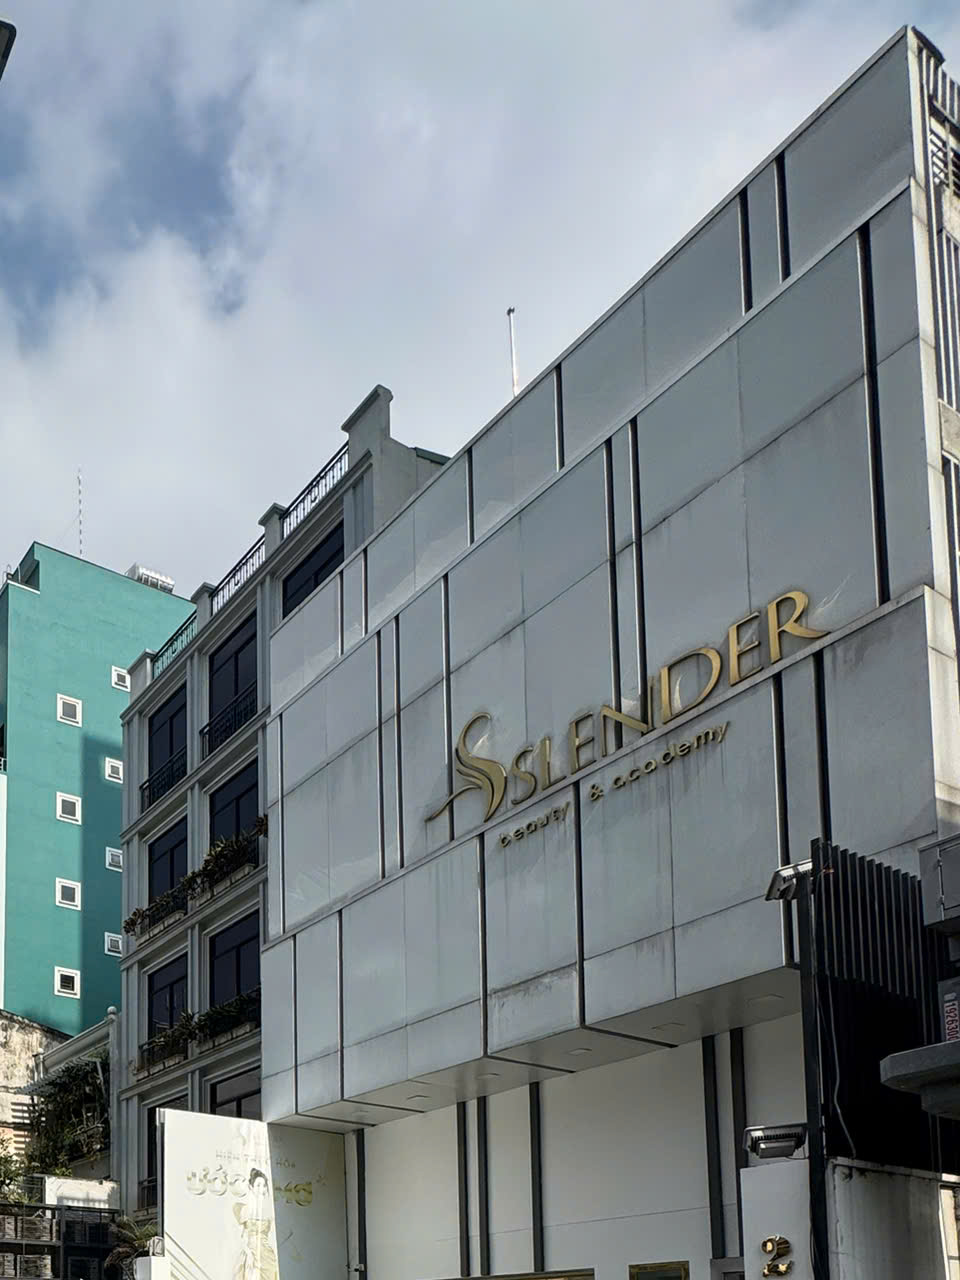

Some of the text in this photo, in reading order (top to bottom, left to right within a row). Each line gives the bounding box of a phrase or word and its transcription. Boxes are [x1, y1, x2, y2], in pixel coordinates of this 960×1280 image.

[498, 720, 731, 848] beauty & academy
